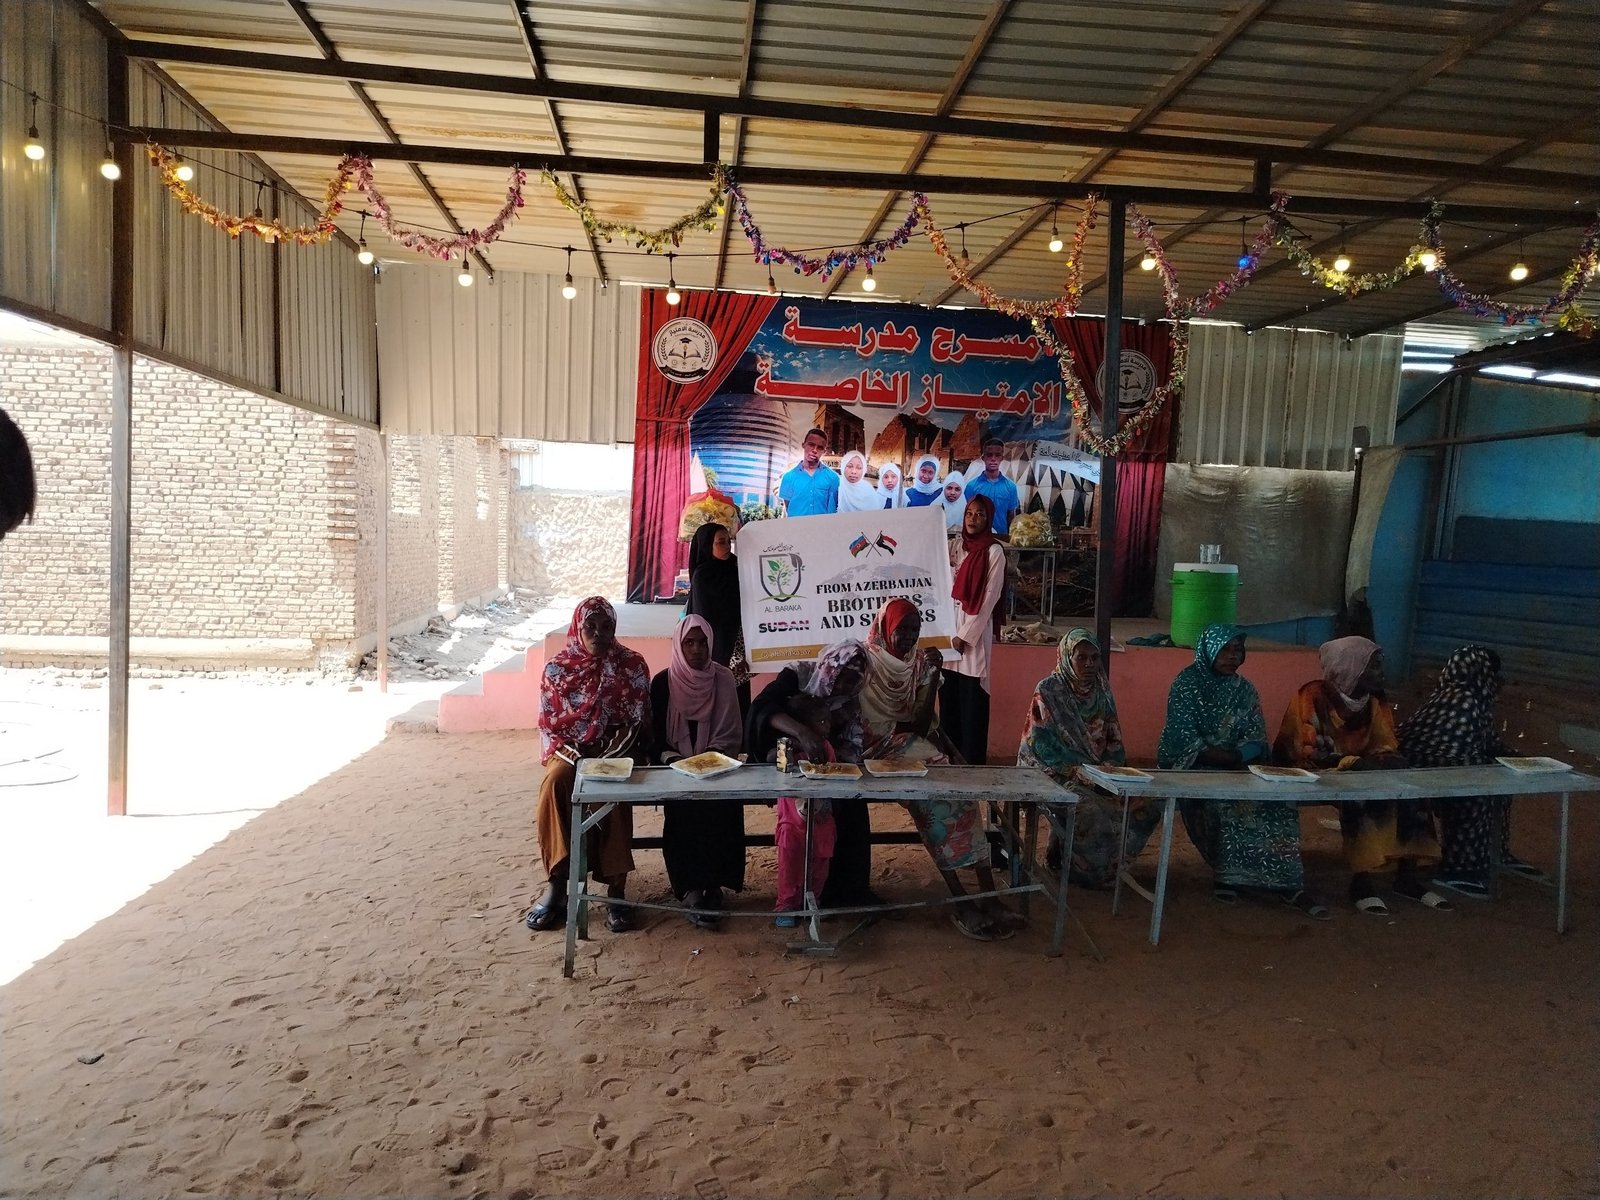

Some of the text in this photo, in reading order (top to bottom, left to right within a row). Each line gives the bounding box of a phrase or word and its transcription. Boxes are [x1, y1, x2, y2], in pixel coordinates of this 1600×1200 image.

[782, 306, 1043, 364] مسرح مدرسة
[754, 360, 911, 408] الخاصة
[816, 577, 933, 595] FROM AZERBAIJAN
[775, 604, 802, 613] BARAKA
[758, 620, 810, 634] SUDAN
[820, 615, 855, 630] AND
